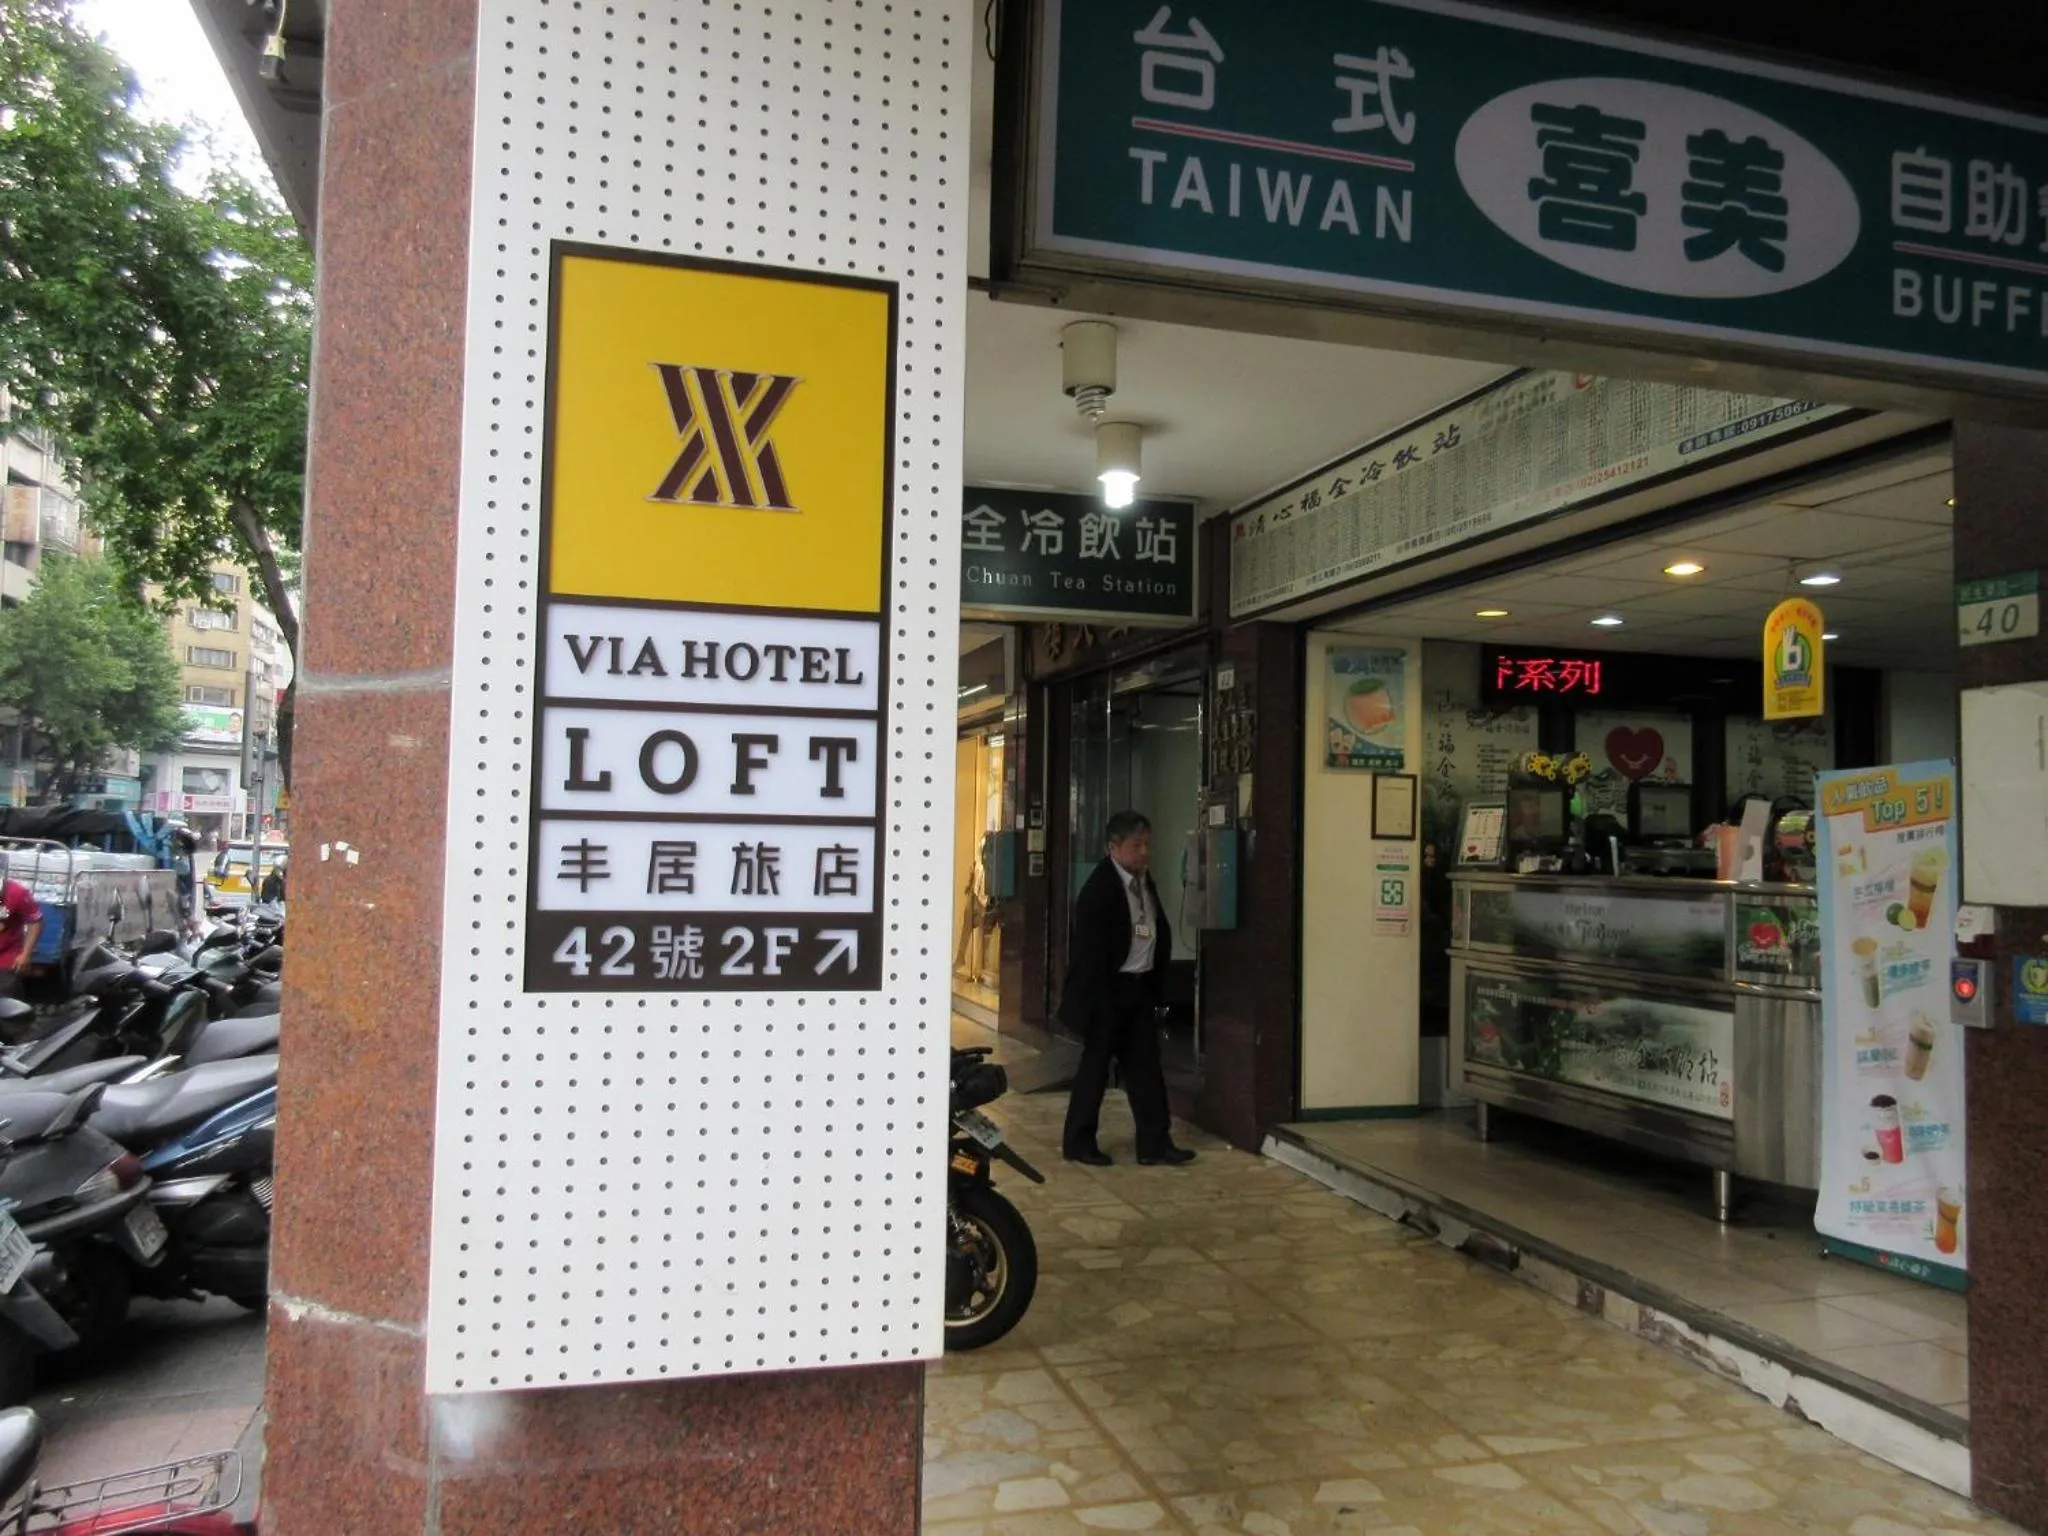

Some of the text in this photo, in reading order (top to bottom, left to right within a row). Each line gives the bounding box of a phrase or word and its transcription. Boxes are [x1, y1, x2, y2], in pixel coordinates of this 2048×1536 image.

[1132, 5, 1416, 147] 台式
[1128, 147, 1412, 242] TAIWAN
[1529, 102, 1788, 274] 喜美
[962, 504, 1176, 564] 全冷飲站
[966, 566, 1177, 596] Chuan Tea Station
[1977, 603, 2020, 637] 40
[564, 634, 864, 686] VIA HOTEL
[564, 727, 858, 799] LOFT
[1872, 800, 1906, 824] Top
[556, 837, 861, 897] 丰居旅店
[719, 926, 800, 976] 2F
